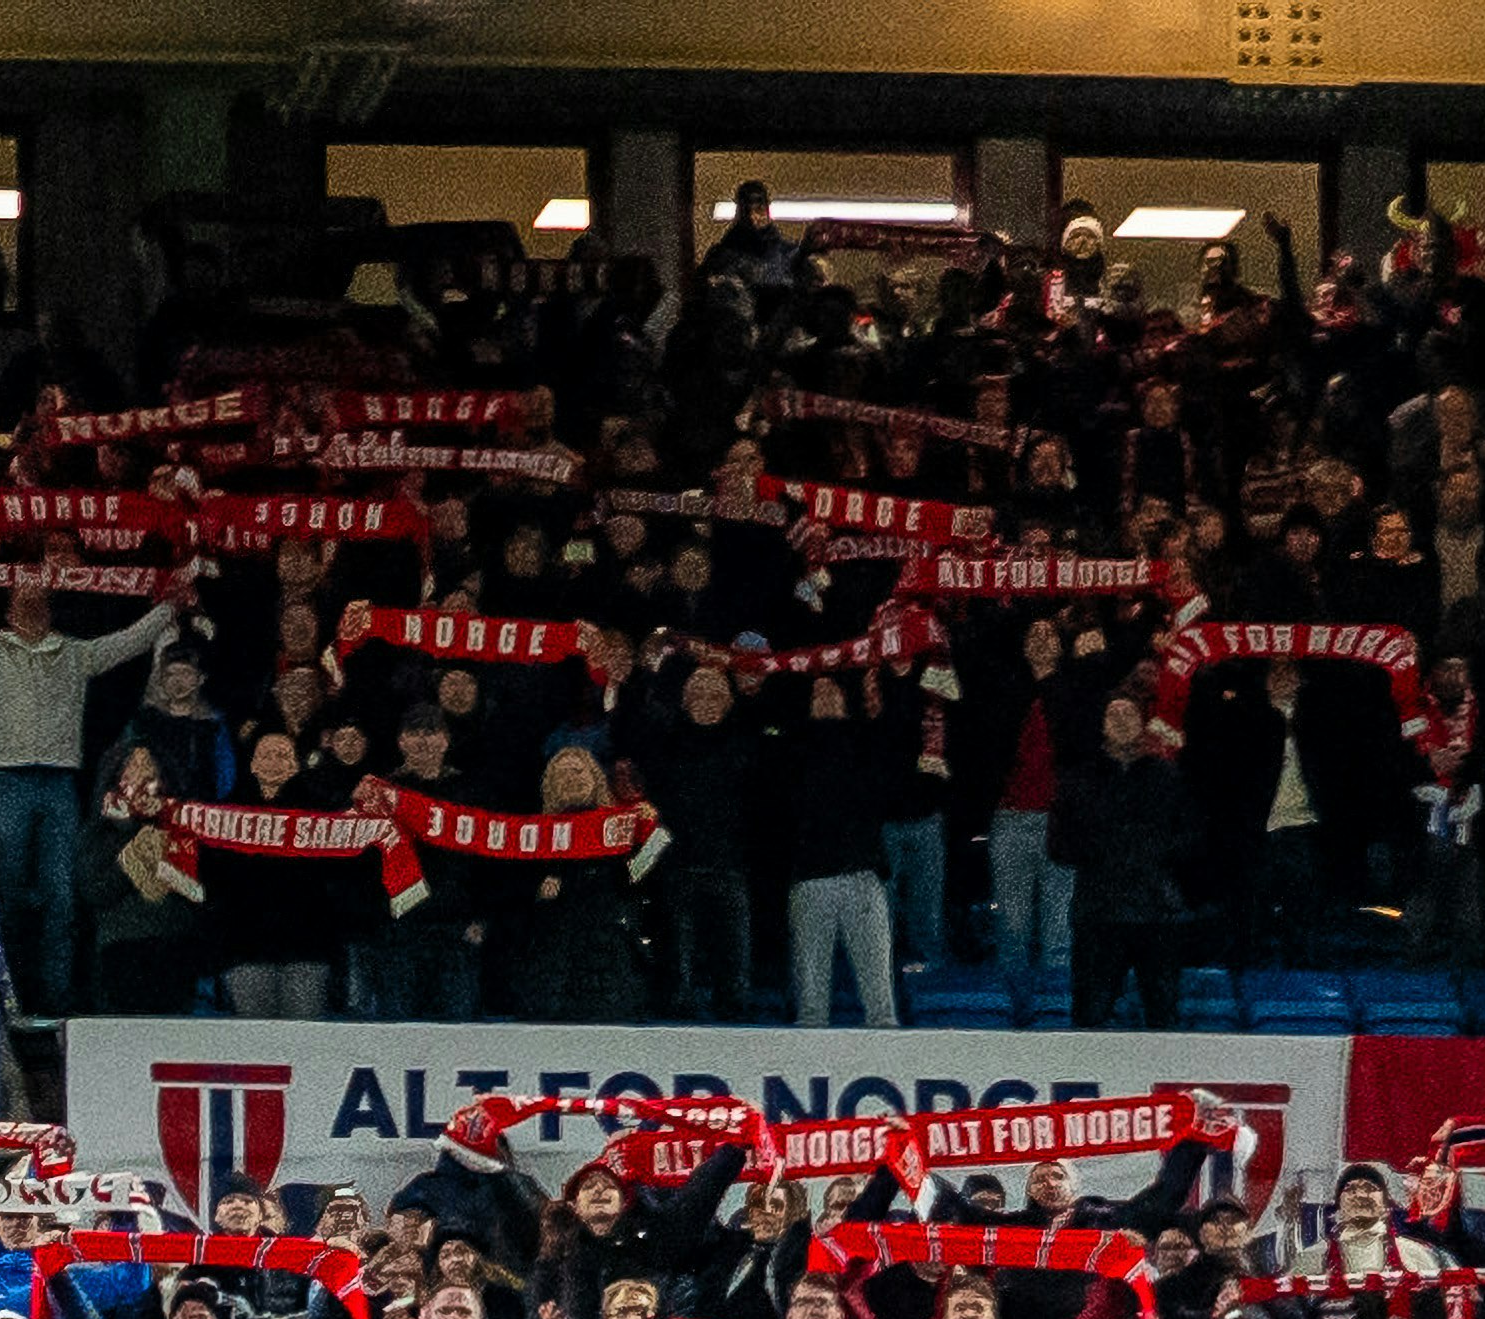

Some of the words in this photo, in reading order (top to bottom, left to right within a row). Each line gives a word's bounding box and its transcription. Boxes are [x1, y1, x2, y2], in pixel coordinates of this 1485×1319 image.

[928, 1119, 981, 1157] ALT
[992, 1111, 1055, 1151] FOR
[1065, 1103, 1175, 1148] NORGE
